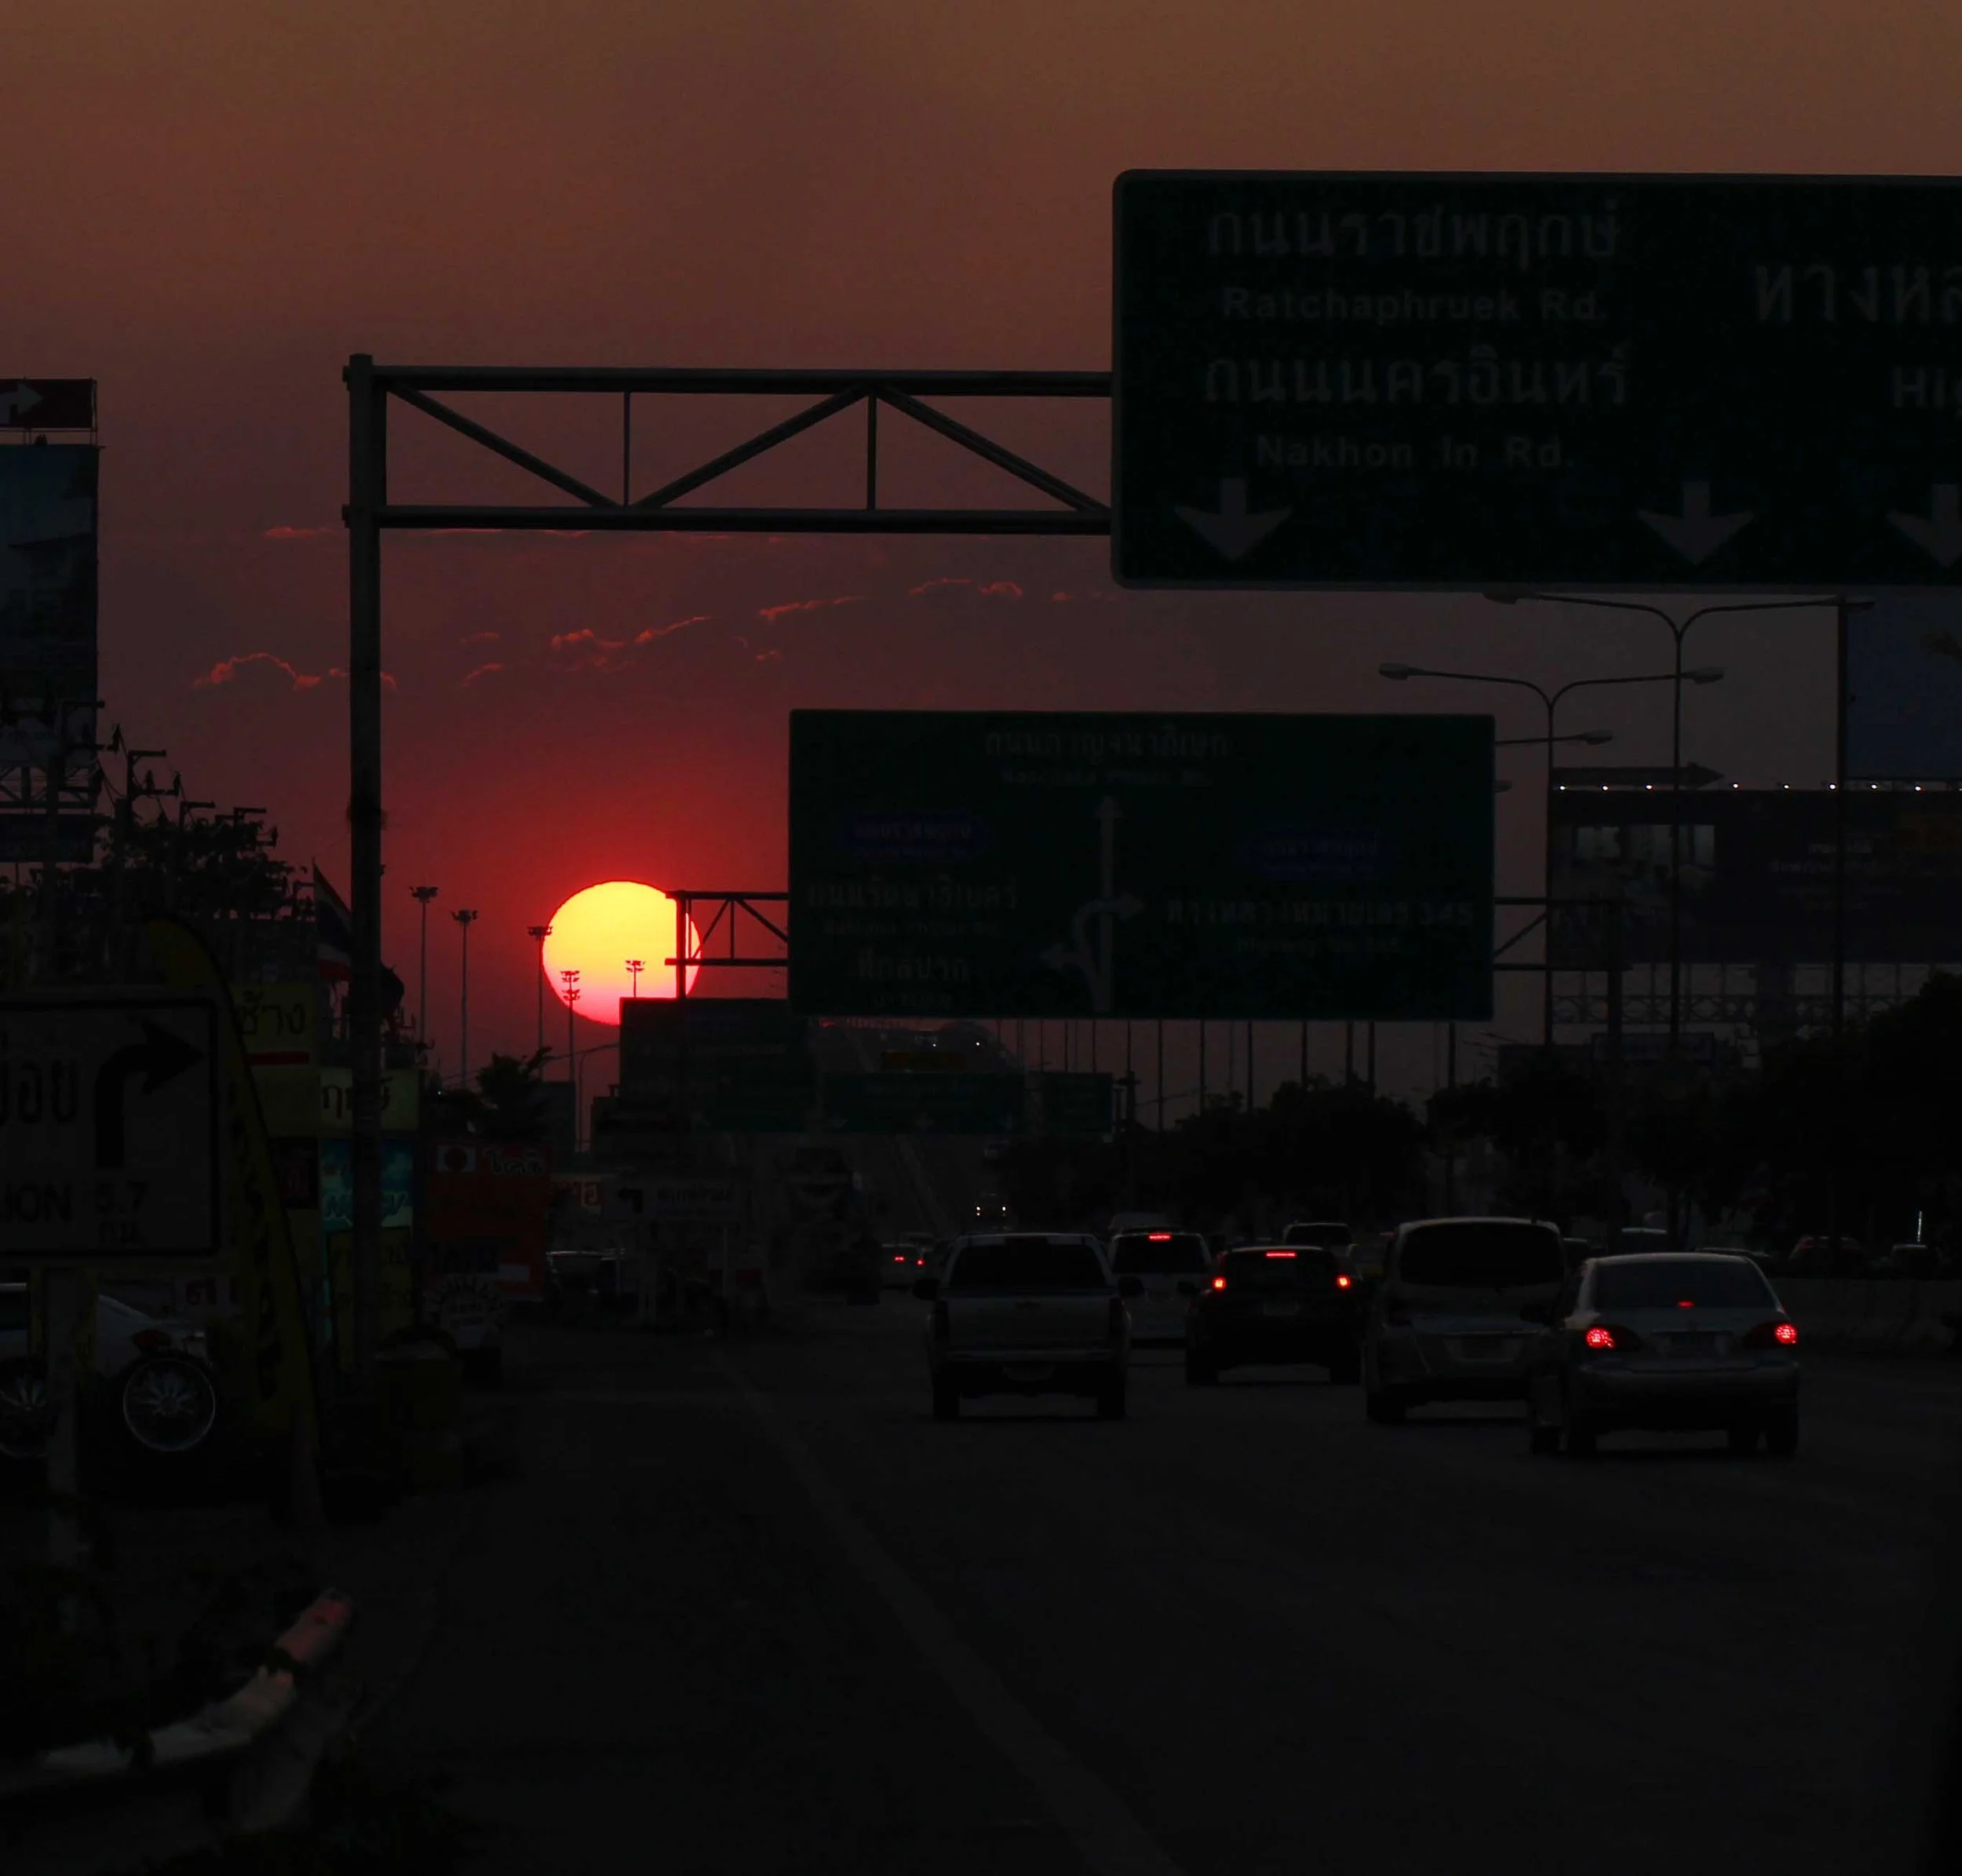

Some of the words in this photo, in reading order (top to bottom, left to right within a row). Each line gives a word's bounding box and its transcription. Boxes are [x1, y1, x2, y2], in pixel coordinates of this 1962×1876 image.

[1209, 198, 1621, 271] ถนนราชพฤกษ์
[1222, 285, 1521, 326] Ratchaphruek
[1205, 340, 1634, 407] ถนนนครอินทร์
[1256, 435, 1413, 468] Nakhon
[1440, 436, 1479, 468] In
[1417, 900, 1475, 927] 345
